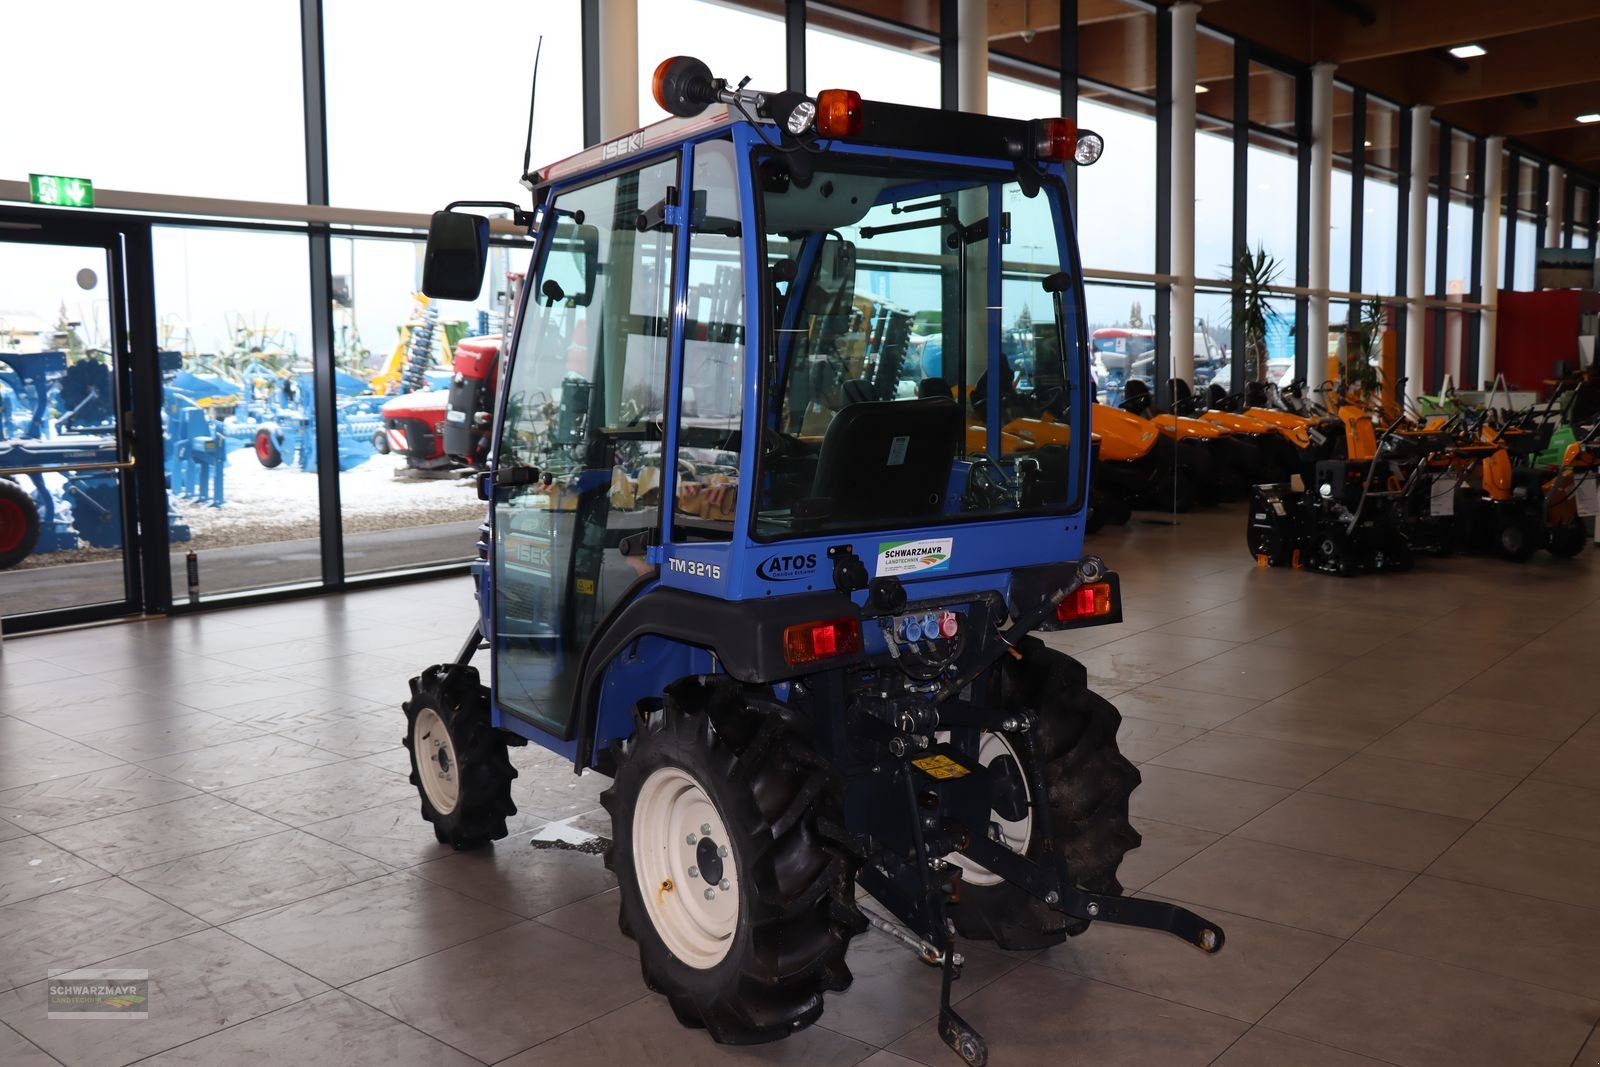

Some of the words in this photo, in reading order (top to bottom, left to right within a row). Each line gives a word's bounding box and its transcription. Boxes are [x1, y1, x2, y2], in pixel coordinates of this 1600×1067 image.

[602, 131, 645, 160] ISEKI
[516, 543, 552, 567] ISEK
[885, 546, 942, 558] SCHWARZMAYR
[885, 557, 919, 565] LANDTECHNIK
[668, 557, 686, 573] TM
[688, 561, 721, 580] 3215
[768, 553, 817, 573] ATOS
